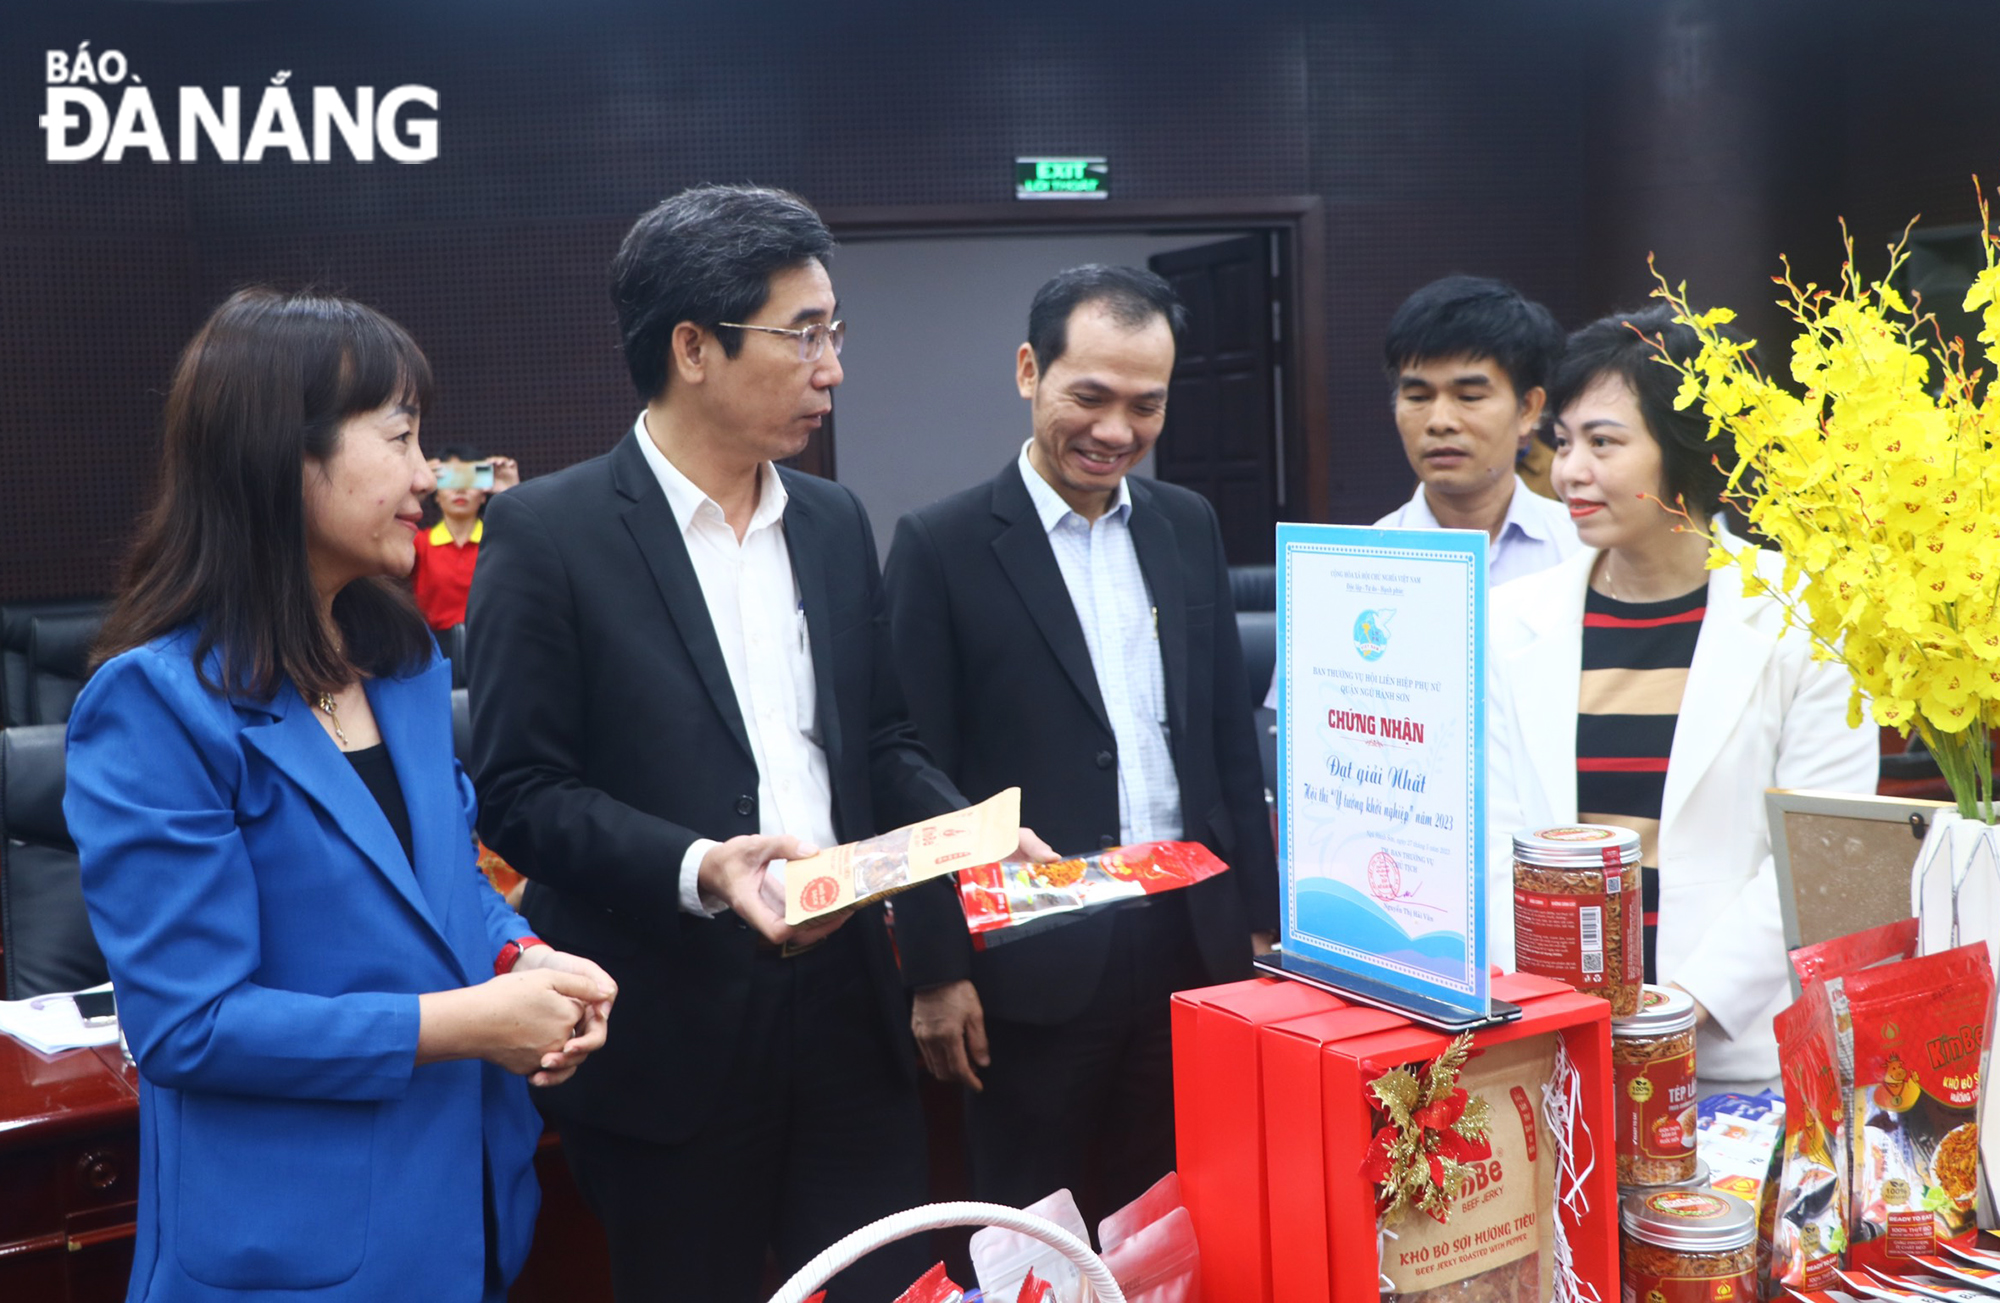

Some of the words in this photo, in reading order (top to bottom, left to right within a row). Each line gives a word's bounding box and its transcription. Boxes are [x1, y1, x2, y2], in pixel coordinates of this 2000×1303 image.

[1036, 161, 1087, 179] EXIT
[1313, 666, 1326, 676] BAN
[1327, 667, 1354, 680] THƯỜNG
[1355, 672, 1364, 683] VỤ
[1365, 672, 1378, 684] HỘI
[1379, 674, 1395, 686] LIÊN
[1396, 677, 1414, 689] HIỆP
[1415, 680, 1429, 692] PHỤ
[1430, 680, 1442, 692] NỮ
[1340, 684, 1359, 695] QUẬN
[1360, 687, 1374, 698] NGŨ
[1375, 689, 1395, 701] HÀNH
[1396, 692, 1410, 702] SƠN
[1328, 708, 1376, 735] CHỨNG
[1380, 717, 1424, 745] NHẬN
[1326, 755, 1352, 781] Đạt
[1356, 764, 1383, 786] giải
[1388, 766, 1427, 793] Nhất
[1304, 782, 1317, 804] Hội
[1319, 787, 1329, 803] thi
[1344, 794, 1363, 815] tưởng
[1366, 797, 1382, 815] khởi
[1415, 812, 1432, 827] năm
[1435, 812, 1454, 831] 2023
[1668, 1084, 1686, 1103] TÉP
[1943, 1075, 1959, 1090] KHÔ
[1961, 1074, 1973, 1090] BÒ
[1462, 1197, 1480, 1213] BEEF
[1481, 1184, 1504, 1204] JERKY
[1399, 1246, 1430, 1266] KHÔ
[1432, 1241, 1450, 1259] BÒ
[1452, 1235, 1471, 1253] SỢI
[1475, 1222, 1511, 1246] HƯƠNG
[1513, 1212, 1536, 1231] TIÊU
[1415, 1265, 1435, 1277] BEEF
[1436, 1258, 1457, 1271] JERKY
[1458, 1249, 1488, 1264] ROASTED
[1489, 1242, 1505, 1254] WITH
[1505, 1233, 1528, 1247] PEPPER
